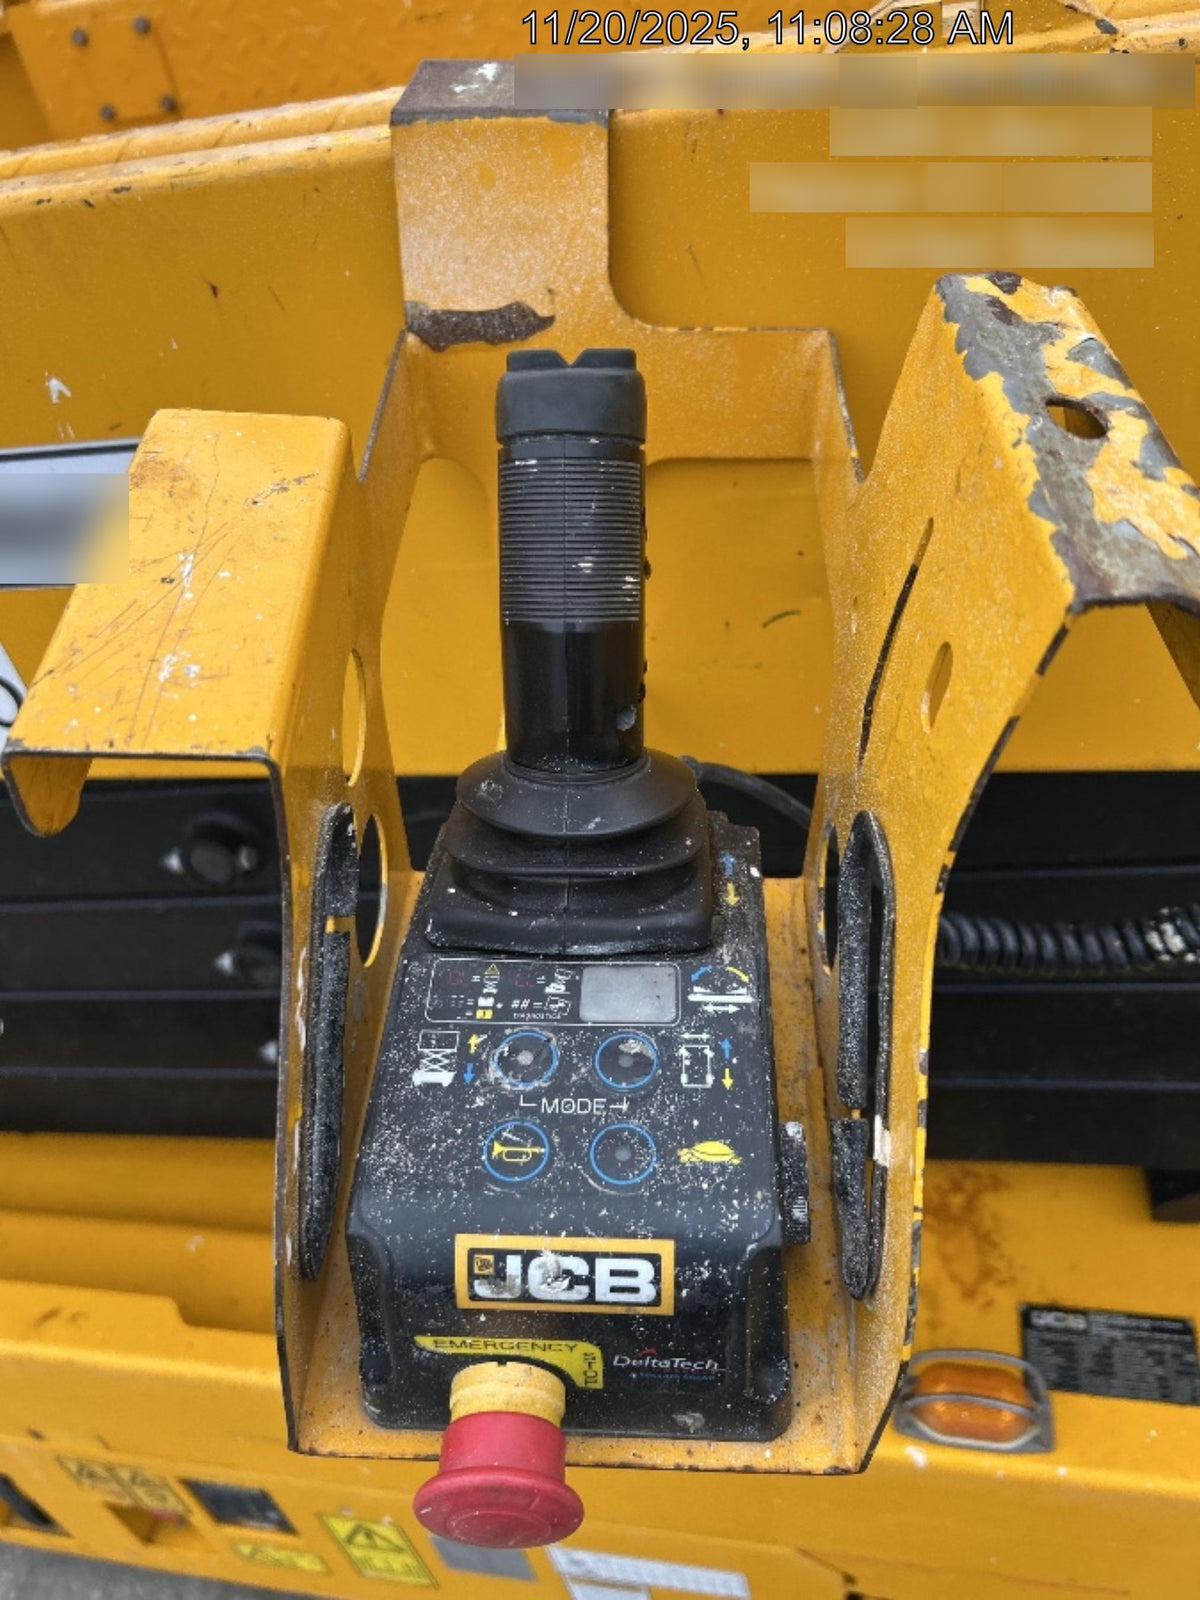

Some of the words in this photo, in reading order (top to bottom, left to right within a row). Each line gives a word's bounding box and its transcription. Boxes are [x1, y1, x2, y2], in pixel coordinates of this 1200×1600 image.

[541, 1097, 607, 1114] MODE
[474, 1253, 657, 1303] JCB
[433, 1339, 579, 1353] EMERGENCY
[612, 1355, 720, 1371] DeltaTech
